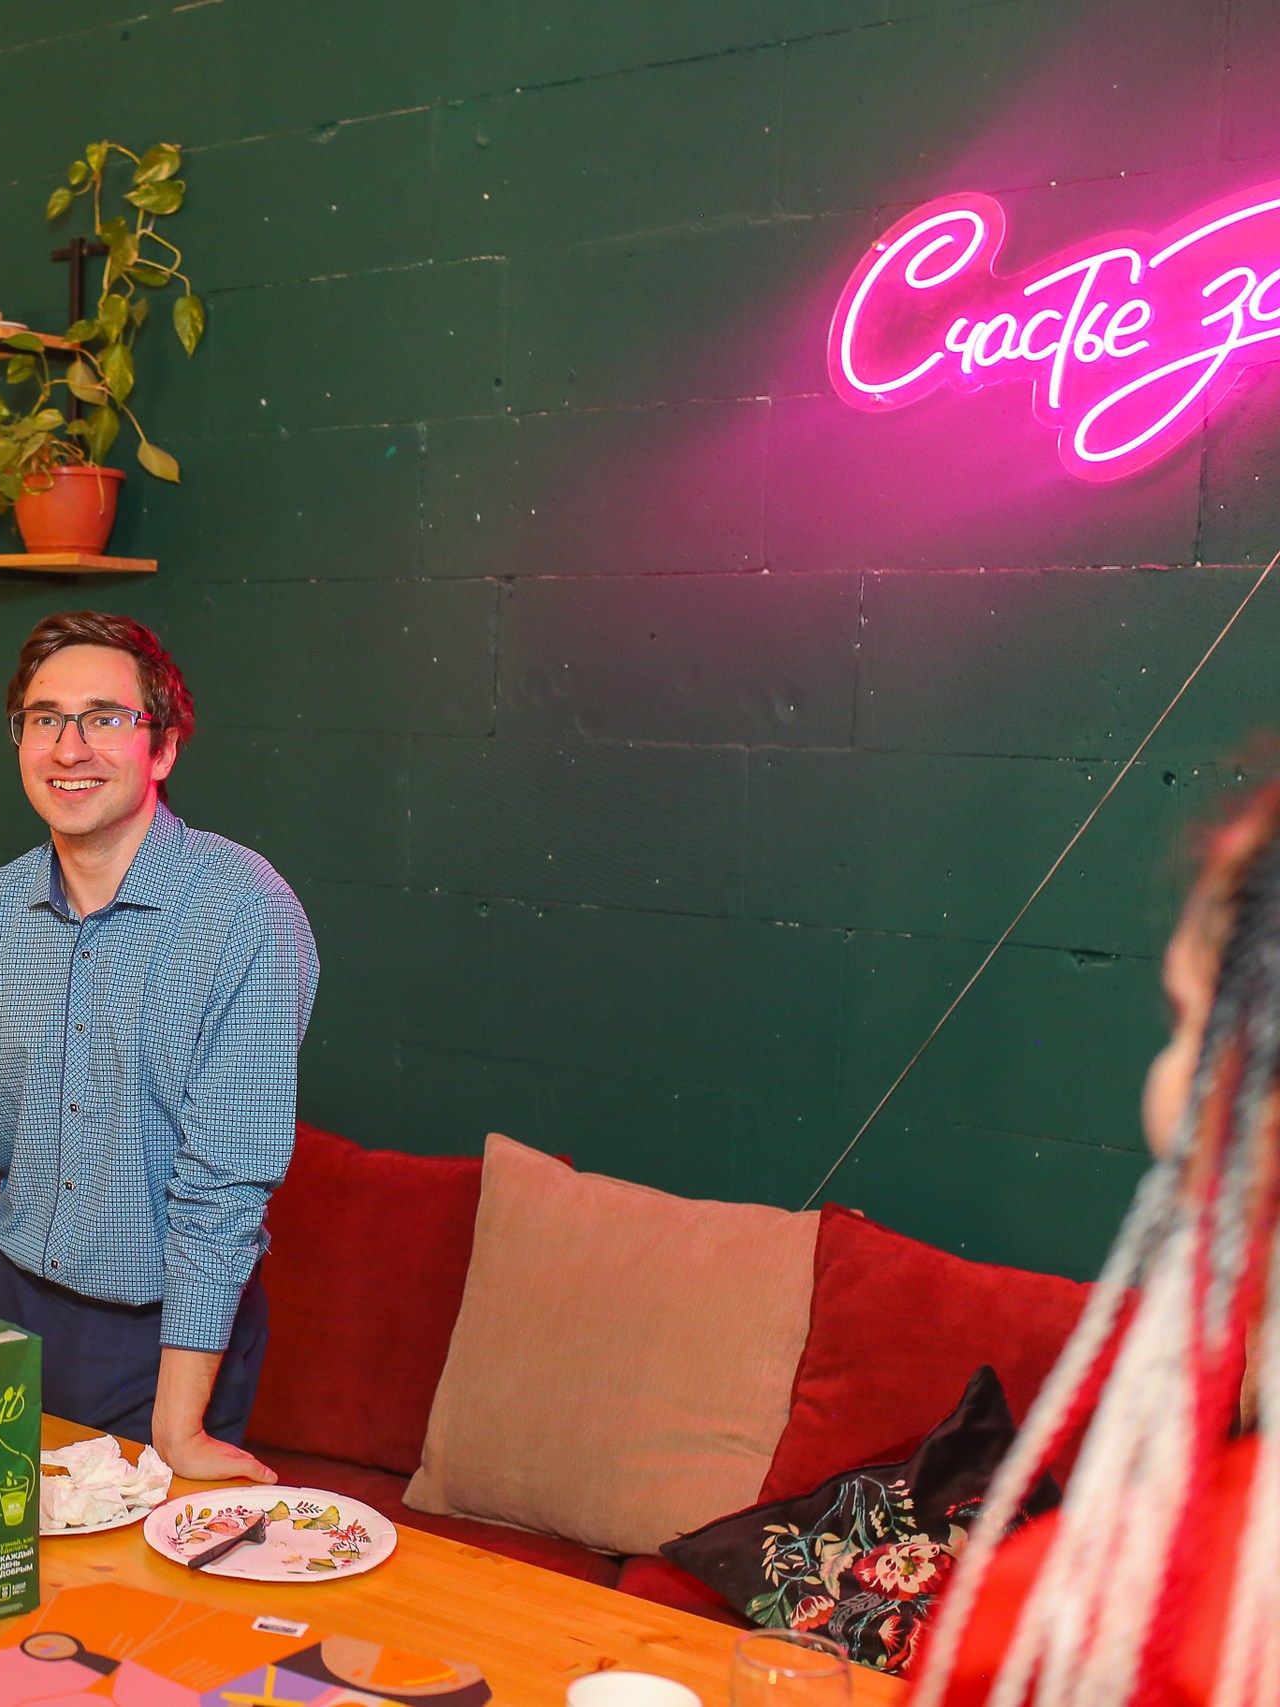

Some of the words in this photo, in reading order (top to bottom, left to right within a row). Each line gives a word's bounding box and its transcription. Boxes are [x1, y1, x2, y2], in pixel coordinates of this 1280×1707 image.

[841, 209, 1153, 409] Счастье
[0, 1547, 34, 1563] КАЖДЫЙ
[0, 1560, 21, 1571] ДЕНЬ
[0, 1563, 34, 1579] ДОБРЫМ
